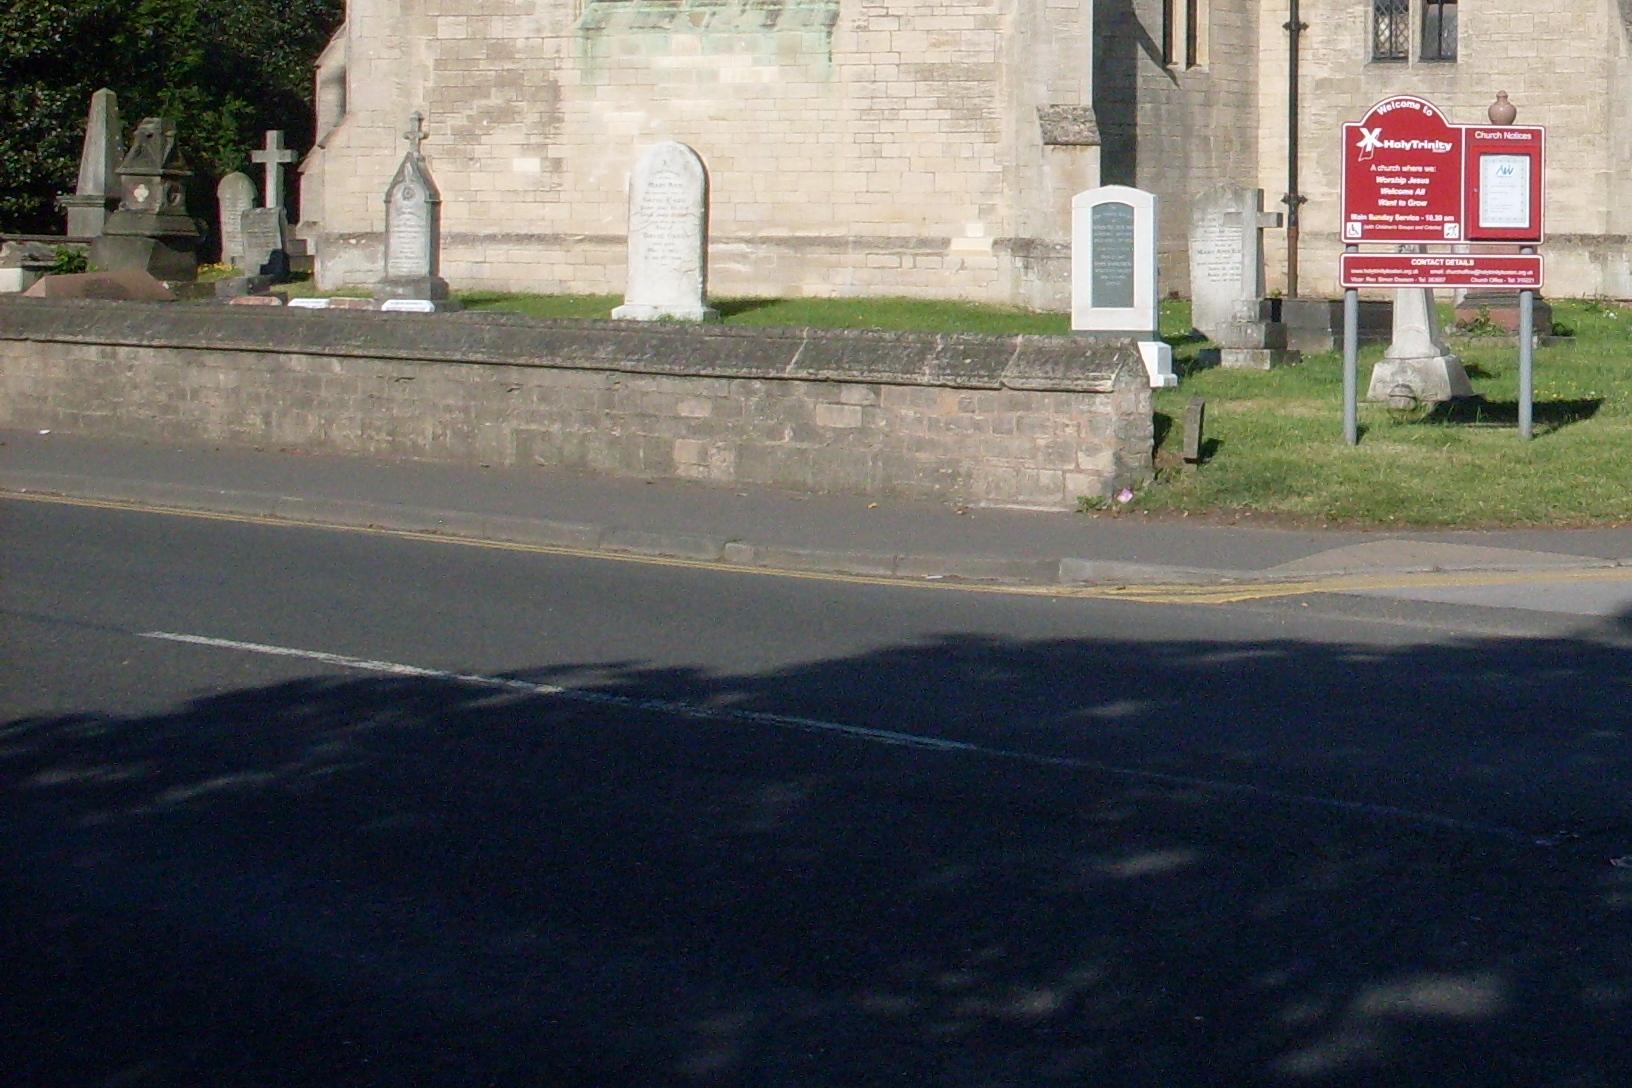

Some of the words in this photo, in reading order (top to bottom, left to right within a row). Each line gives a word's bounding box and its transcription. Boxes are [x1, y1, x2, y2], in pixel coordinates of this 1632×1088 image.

[1376, 101, 1421, 115] Welcome
[1423, 106, 1433, 116] to
[1475, 131, 1502, 140] Church
[1503, 132, 1532, 140] Notices
[1370, 164, 1376, 172] A
[1377, 164, 1401, 172] church
[1376, 176, 1407, 185] Worship
[1408, 176, 1430, 185] Jesus
[1380, 188, 1414, 196] Welcome
[1407, 199, 1428, 207] Grow
[1368, 214, 1394, 222] Sunday
[1395, 214, 1420, 222] Service
